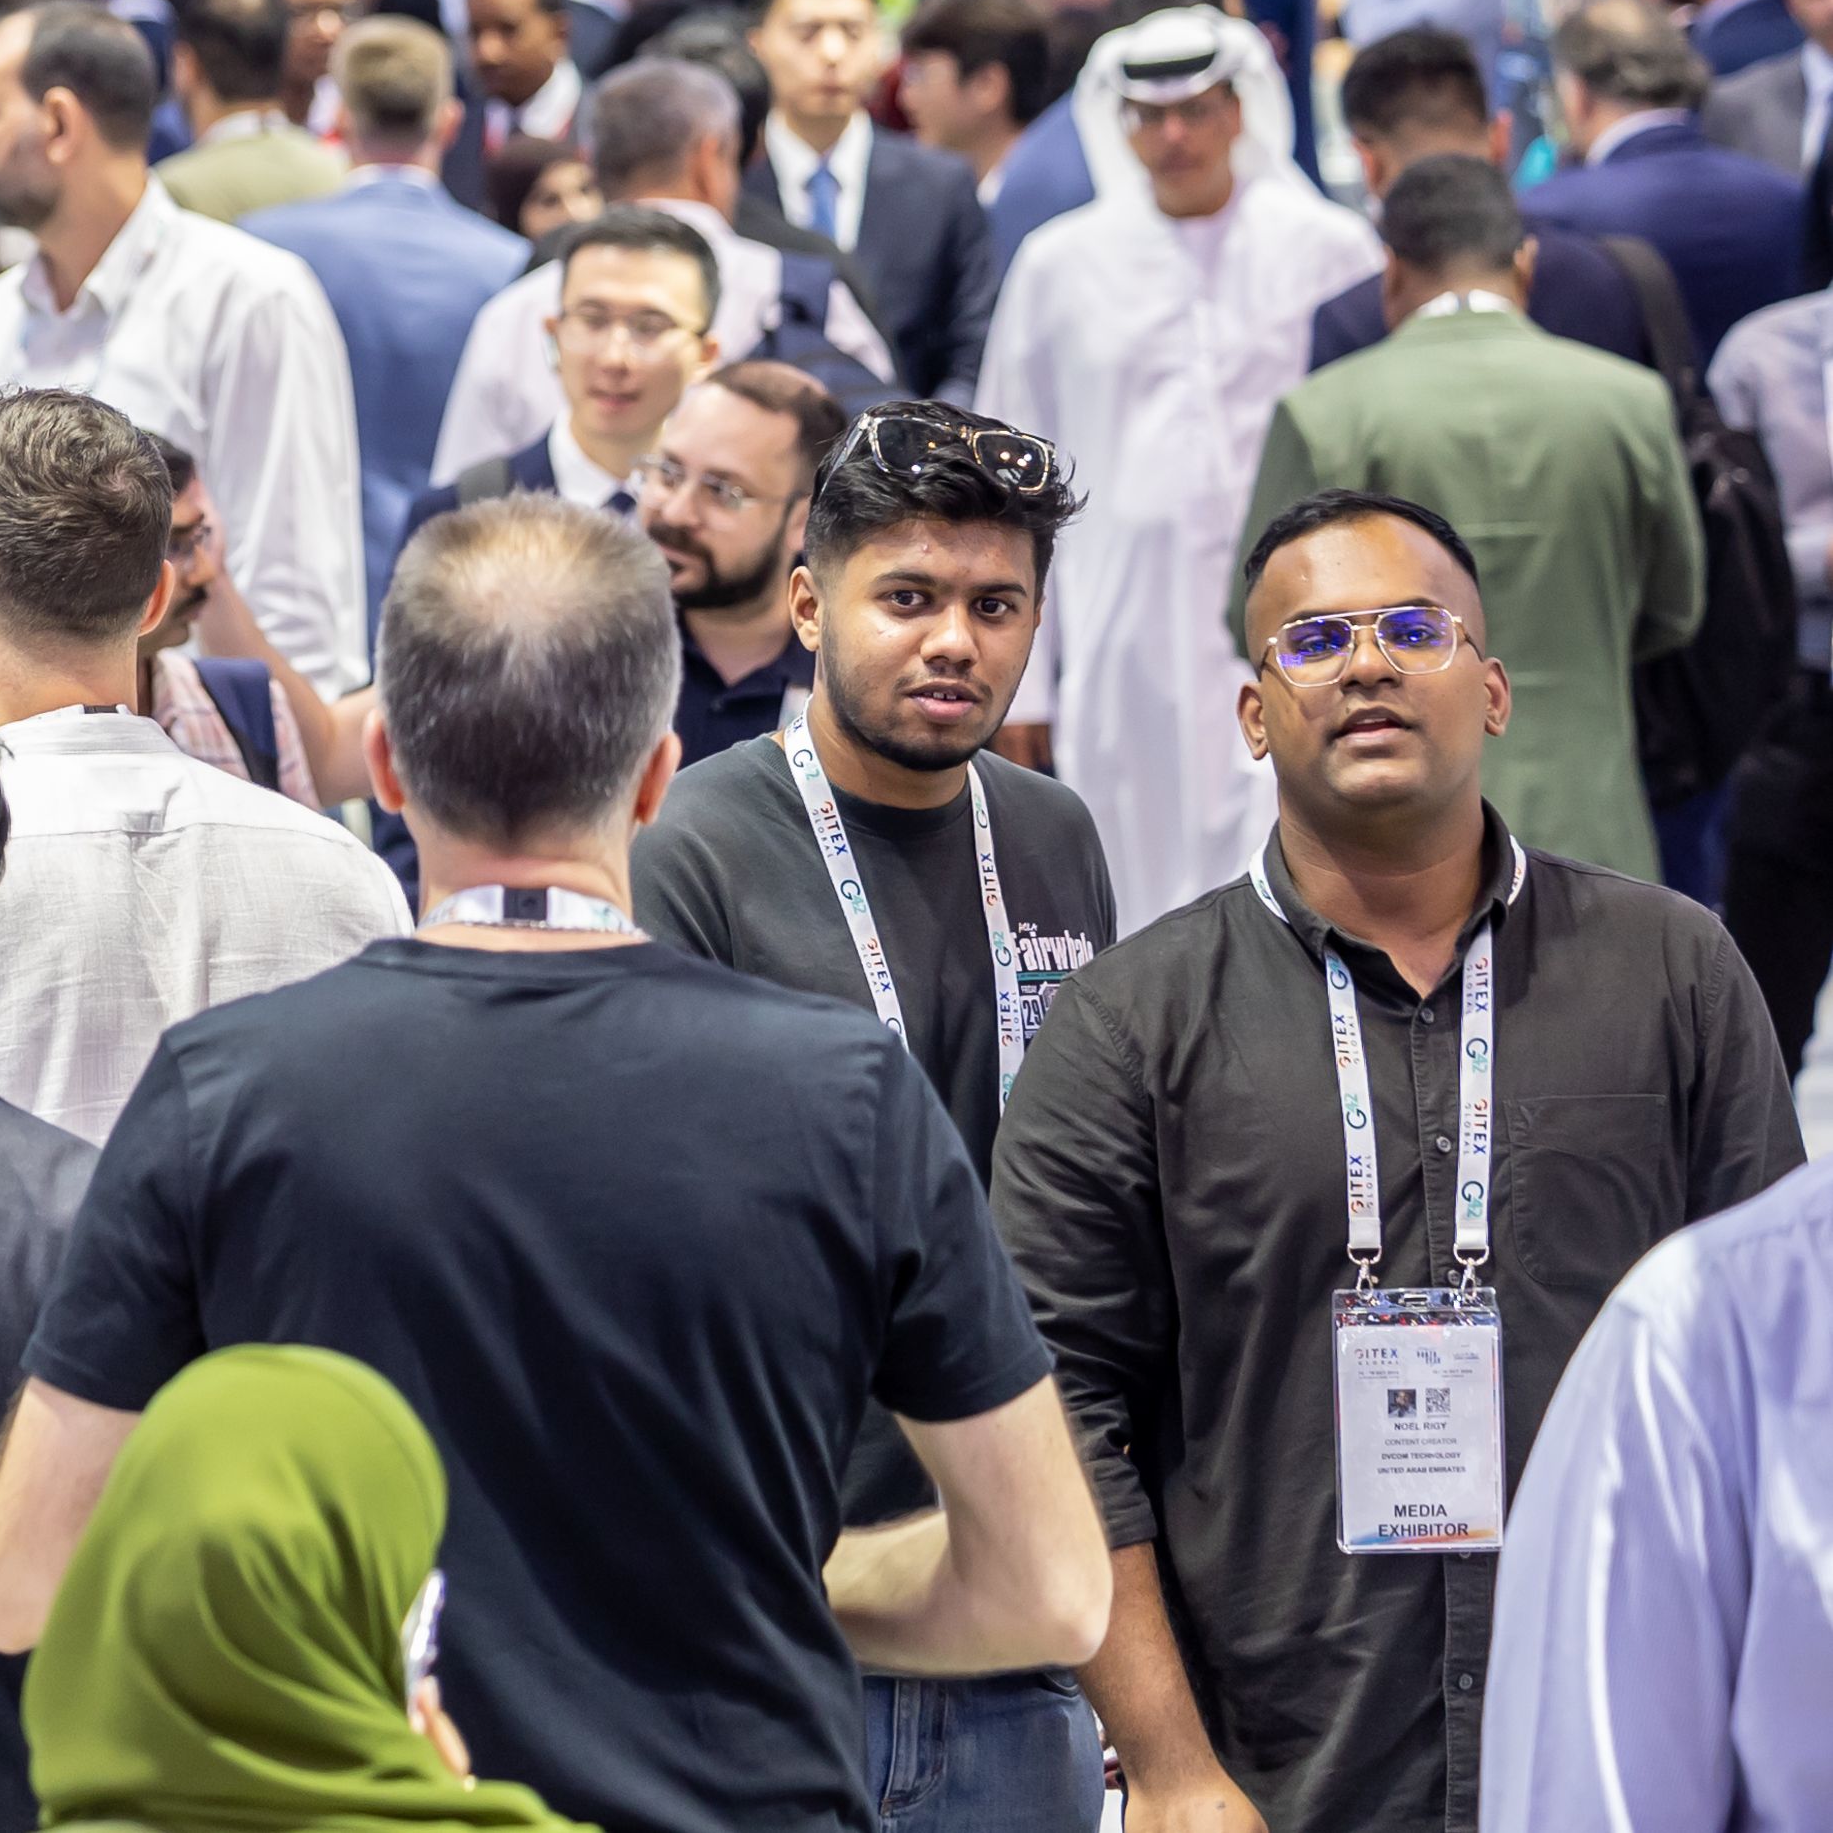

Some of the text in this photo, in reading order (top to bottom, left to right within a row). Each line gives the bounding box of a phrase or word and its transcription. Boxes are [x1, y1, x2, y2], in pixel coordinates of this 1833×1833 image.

[821, 800, 848, 857] GITEX
[840, 879, 867, 916] G42
[981, 852, 1000, 907] GITEX
[866, 937, 892, 993] GITEX
[994, 930, 1013, 967] G42
[1473, 957, 1490, 1013] GITEX
[999, 991, 1013, 1047] GITEX
[1023, 998, 1042, 1027] 29
[1336, 1013, 1352, 1069] GITEX
[1465, 1036, 1490, 1075] G42
[1344, 1092, 1367, 1131] G42
[1472, 1098, 1489, 1156] GITEX
[1349, 1154, 1365, 1215] GITEX
[1460, 1179, 1485, 1220] G42
[1354, 1348, 1399, 1360] GITEX
[1385, 1438, 1457, 1446] CONTENT CREATOR
[1394, 1422, 1420, 1431] NOEL
[1377, 1466, 1466, 1474] UNITED ARAB EMIRATES
[1411, 1452, 1461, 1460] TECHNOLOGY
[1378, 1522, 1469, 1537] EXHIBITOR
[1394, 1504, 1448, 1517] MEDIA
